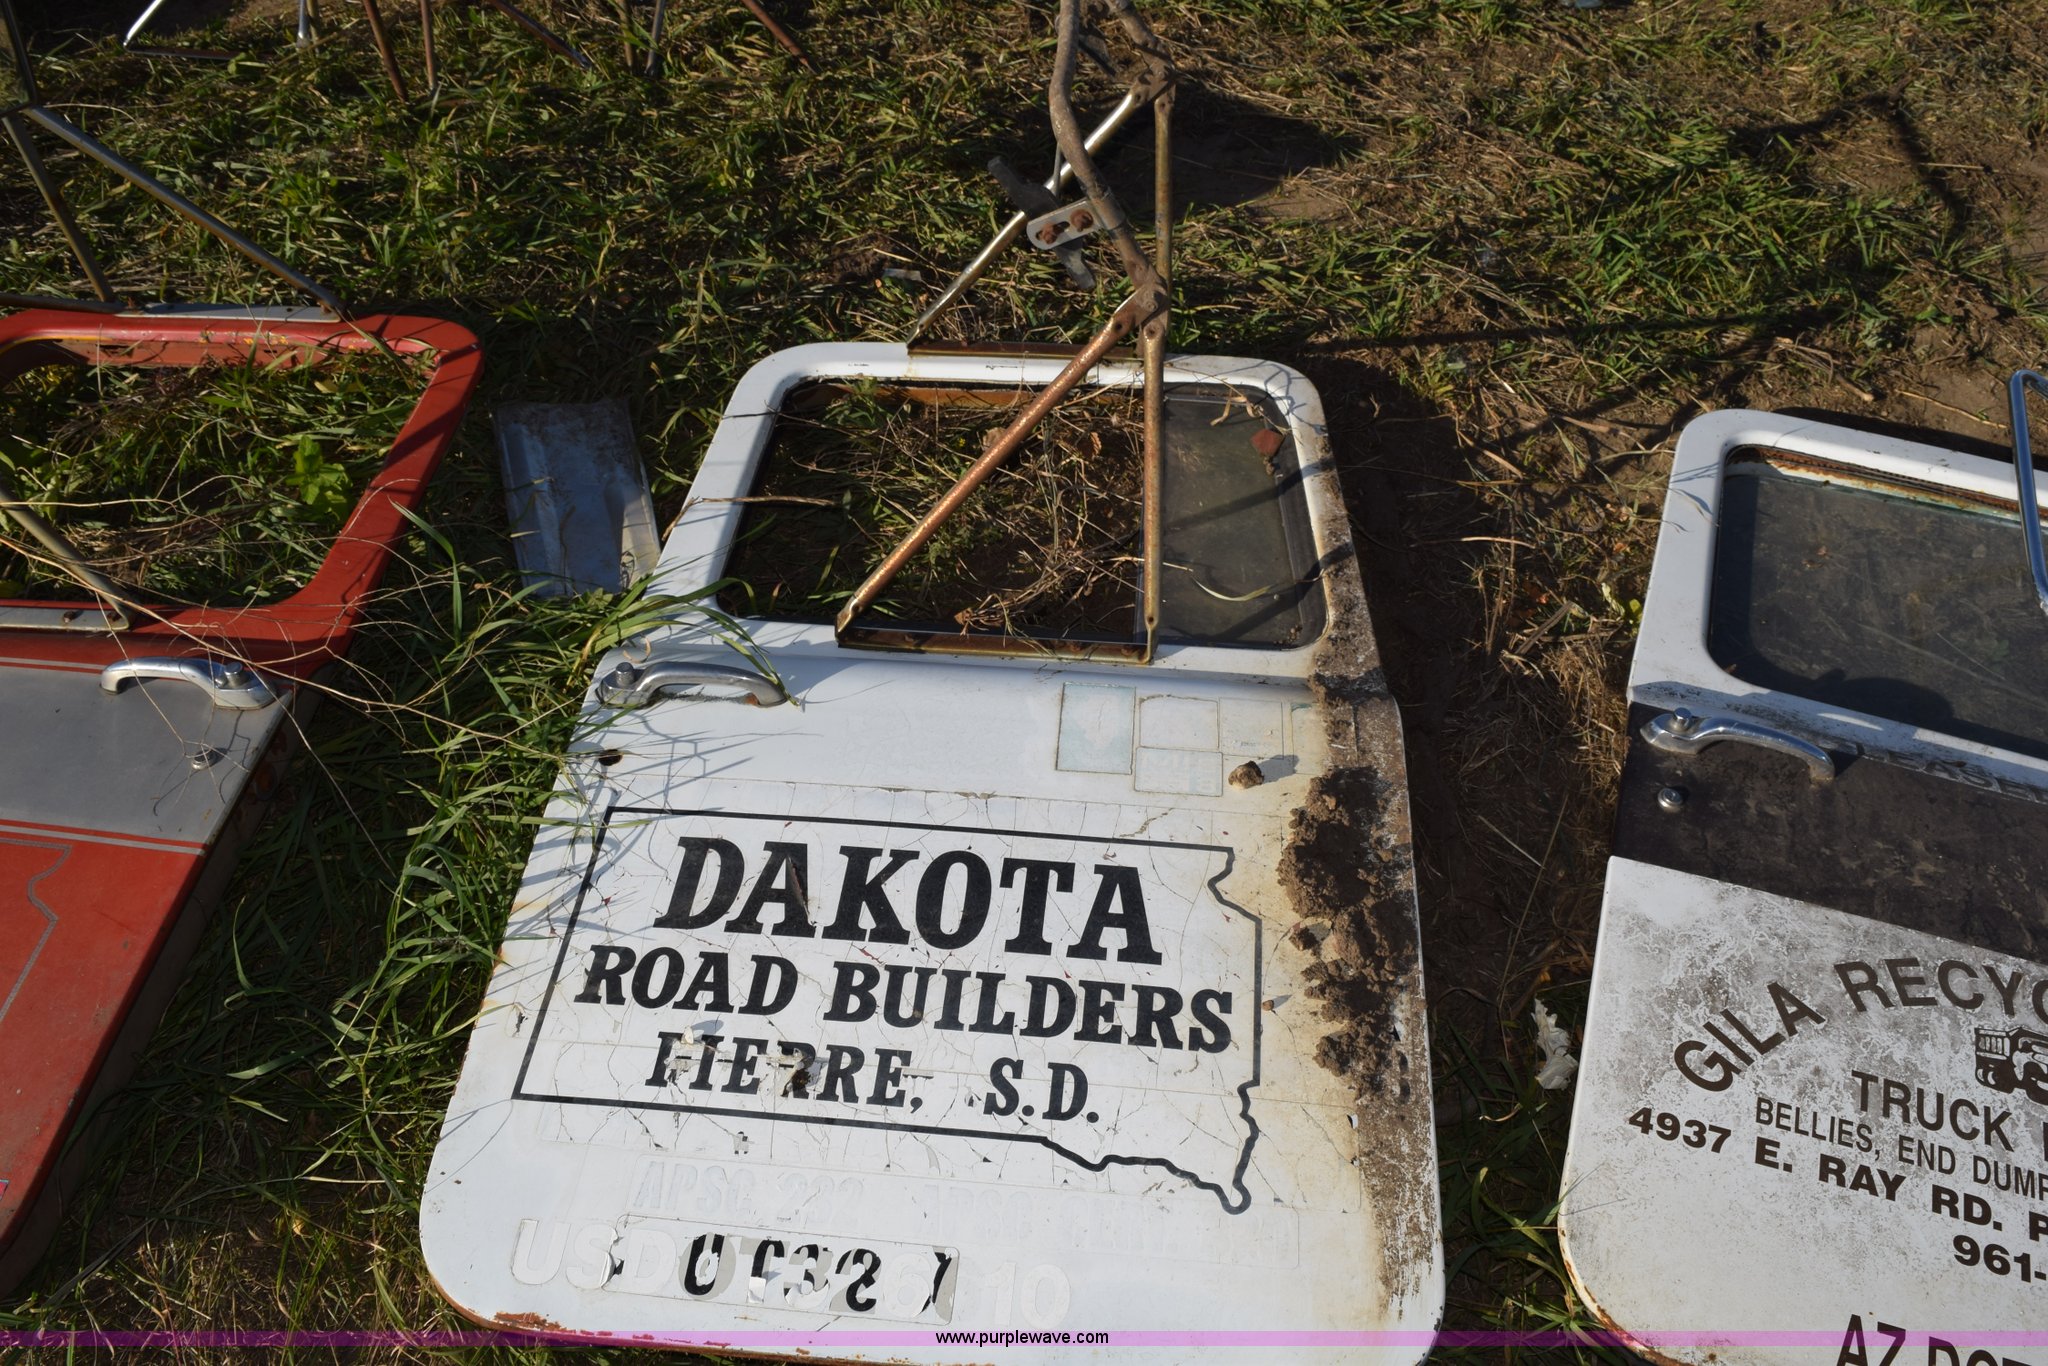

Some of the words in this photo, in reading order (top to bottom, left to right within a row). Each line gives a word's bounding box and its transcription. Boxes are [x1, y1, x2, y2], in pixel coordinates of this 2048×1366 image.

[652, 836, 1163, 966] DAKOTA
[573, 944, 799, 1016] ROAD
[823, 960, 1233, 1054] BUILDERS
[1673, 981, 1827, 1093] GILA
[983, 1057, 1101, 1125] S.D.
[1755, 1096, 1882, 1161] BELLIES,
[1898, 1134, 1957, 1176] END
[1851, 1069, 2015, 1153] TRUCK
[1628, 1106, 1732, 1154] 4937
[1754, 1136, 1794, 1173] E.
[1818, 1153, 1907, 1202] RAY
[1931, 1184, 2004, 1232] RD.
[1952, 1234, 2048, 1284] 961-
